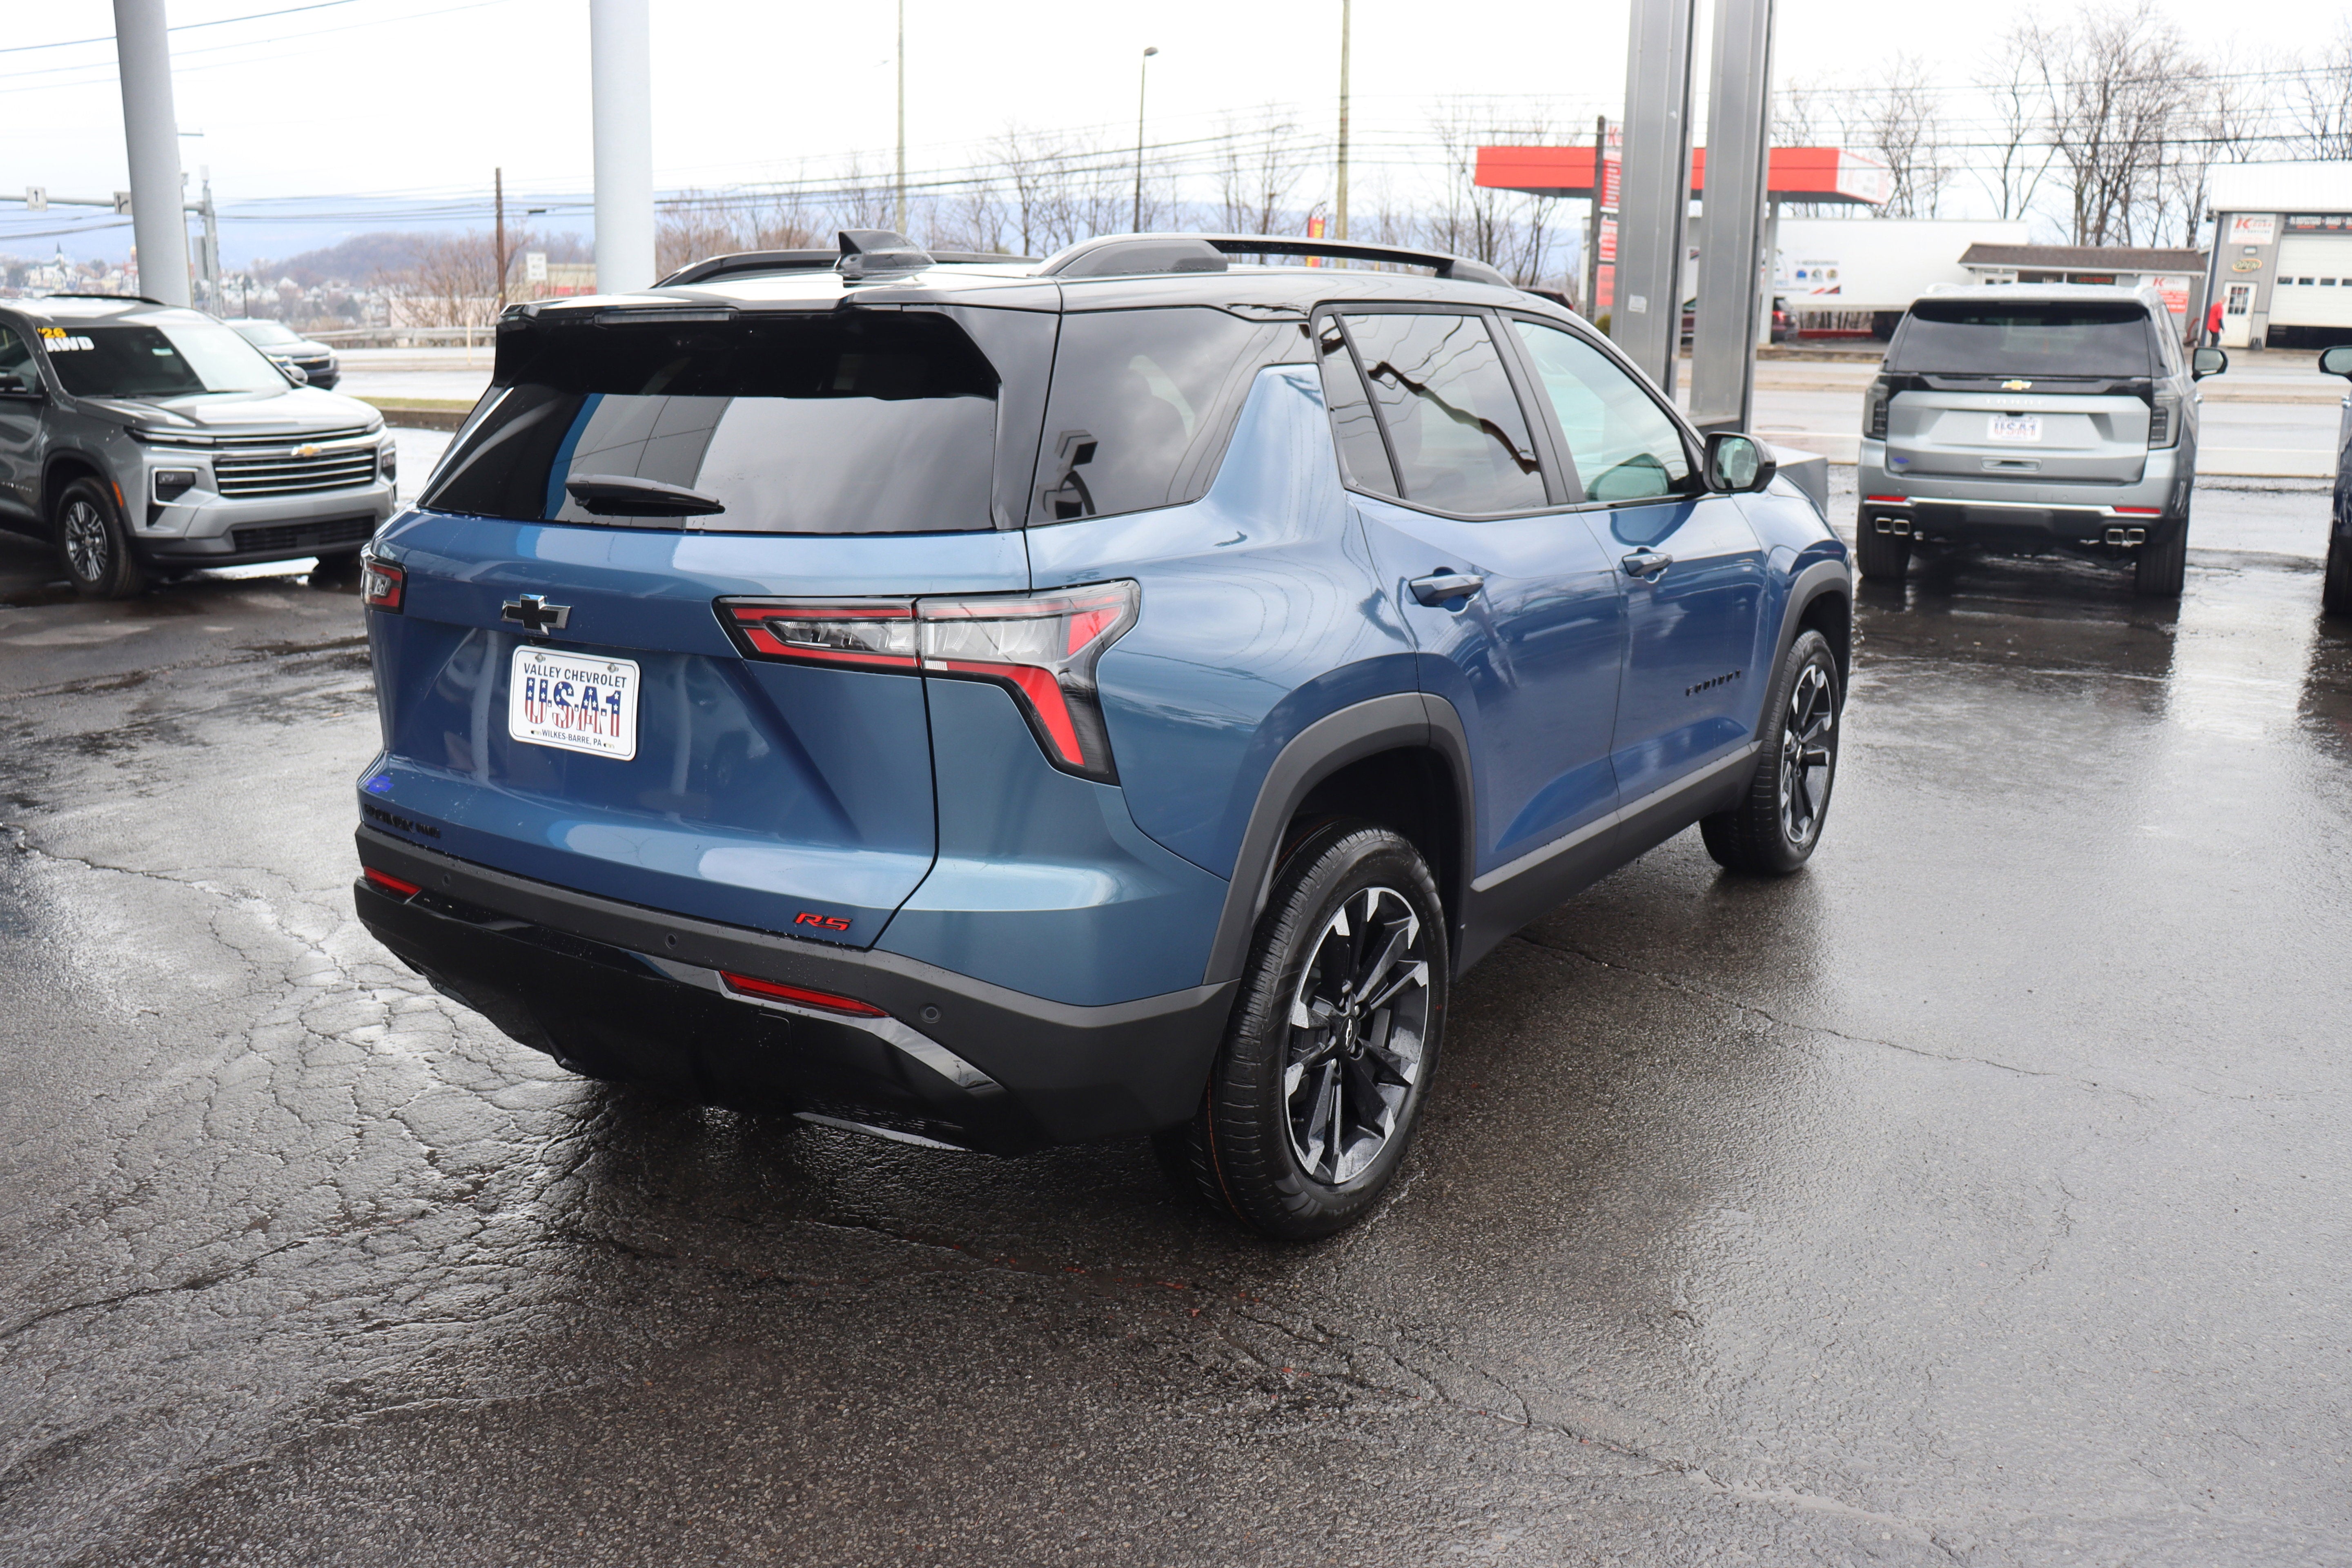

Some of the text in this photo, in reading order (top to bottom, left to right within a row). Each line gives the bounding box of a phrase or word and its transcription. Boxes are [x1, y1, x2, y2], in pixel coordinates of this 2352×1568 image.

[44, 336, 95, 352] AWD
[524, 663, 627, 688] VALLEY CHEVROLET
[542, 729, 602, 746] WILKES-BARRE, PA
[793, 911, 853, 931] RS
